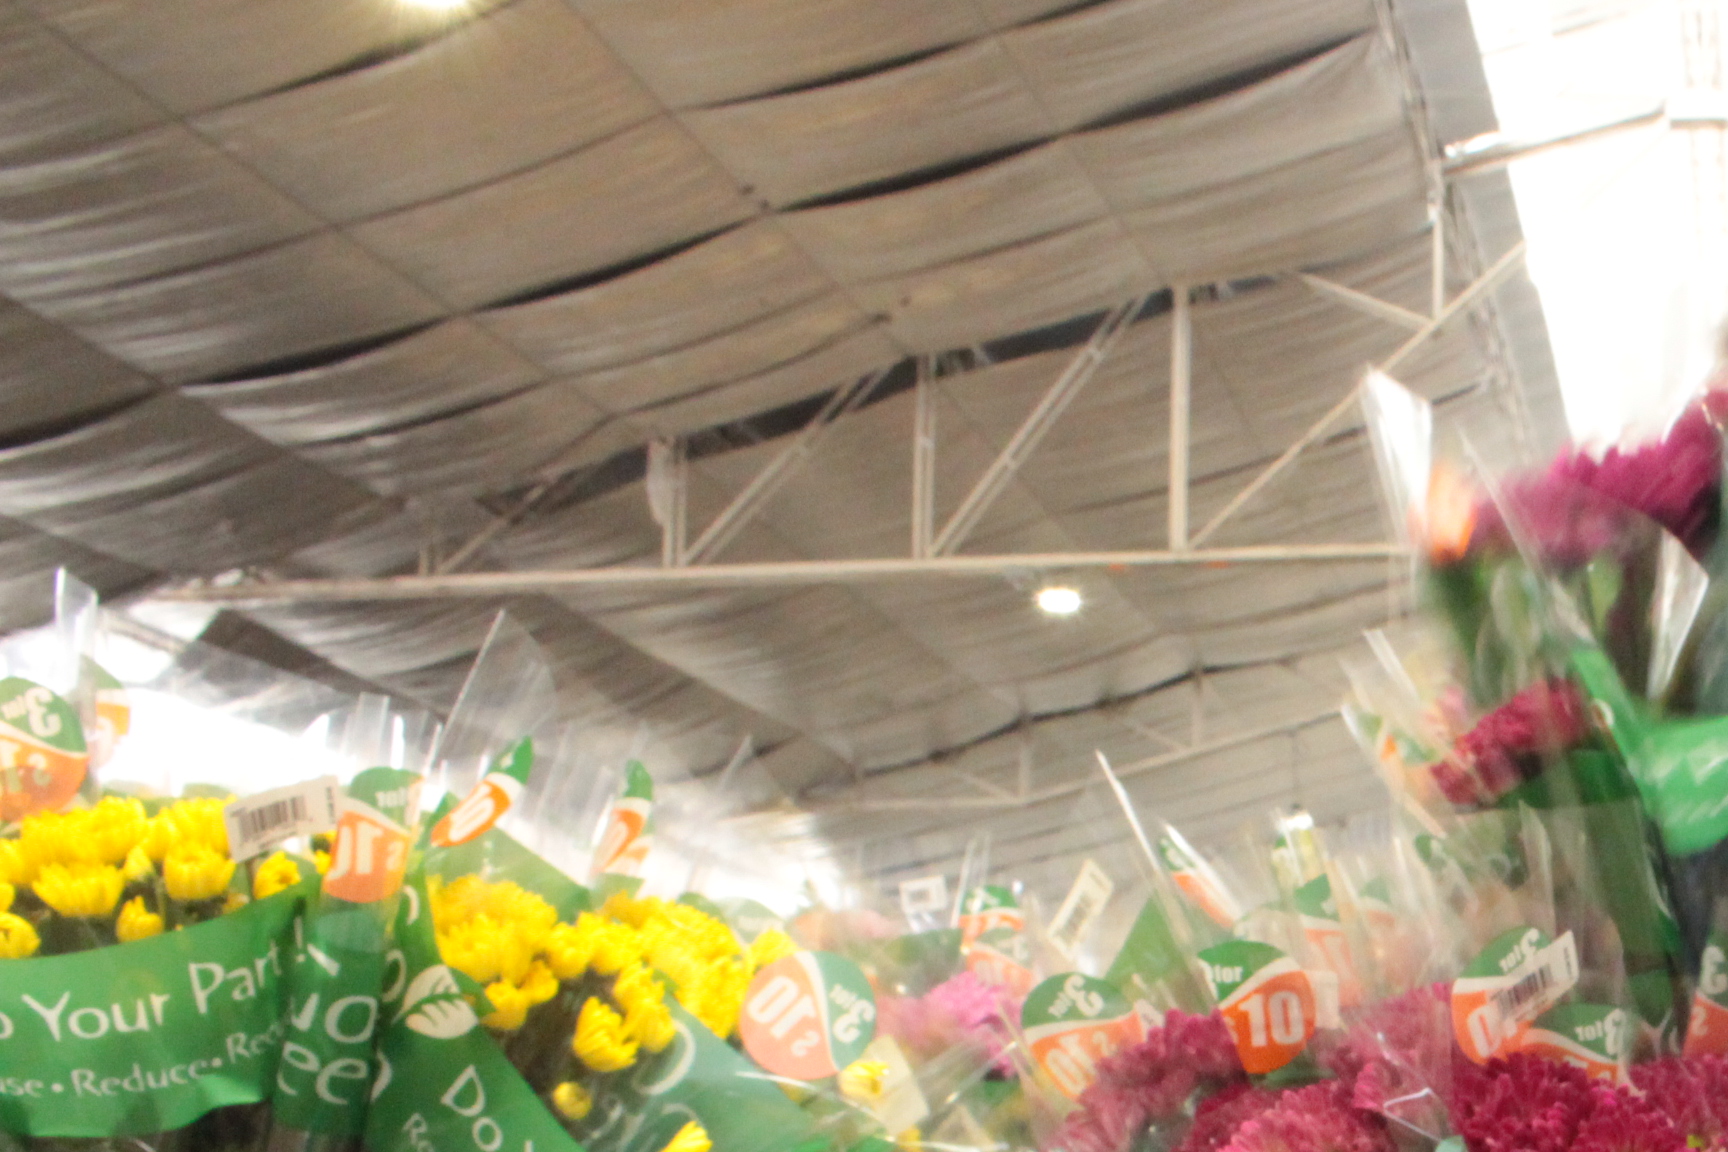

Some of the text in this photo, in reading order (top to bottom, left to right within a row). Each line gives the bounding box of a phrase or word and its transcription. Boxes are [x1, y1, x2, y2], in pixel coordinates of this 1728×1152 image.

[448, 783, 498, 842] 10
[21, 990, 171, 1042] Your
[70, 1062, 208, 1098] Reduce
